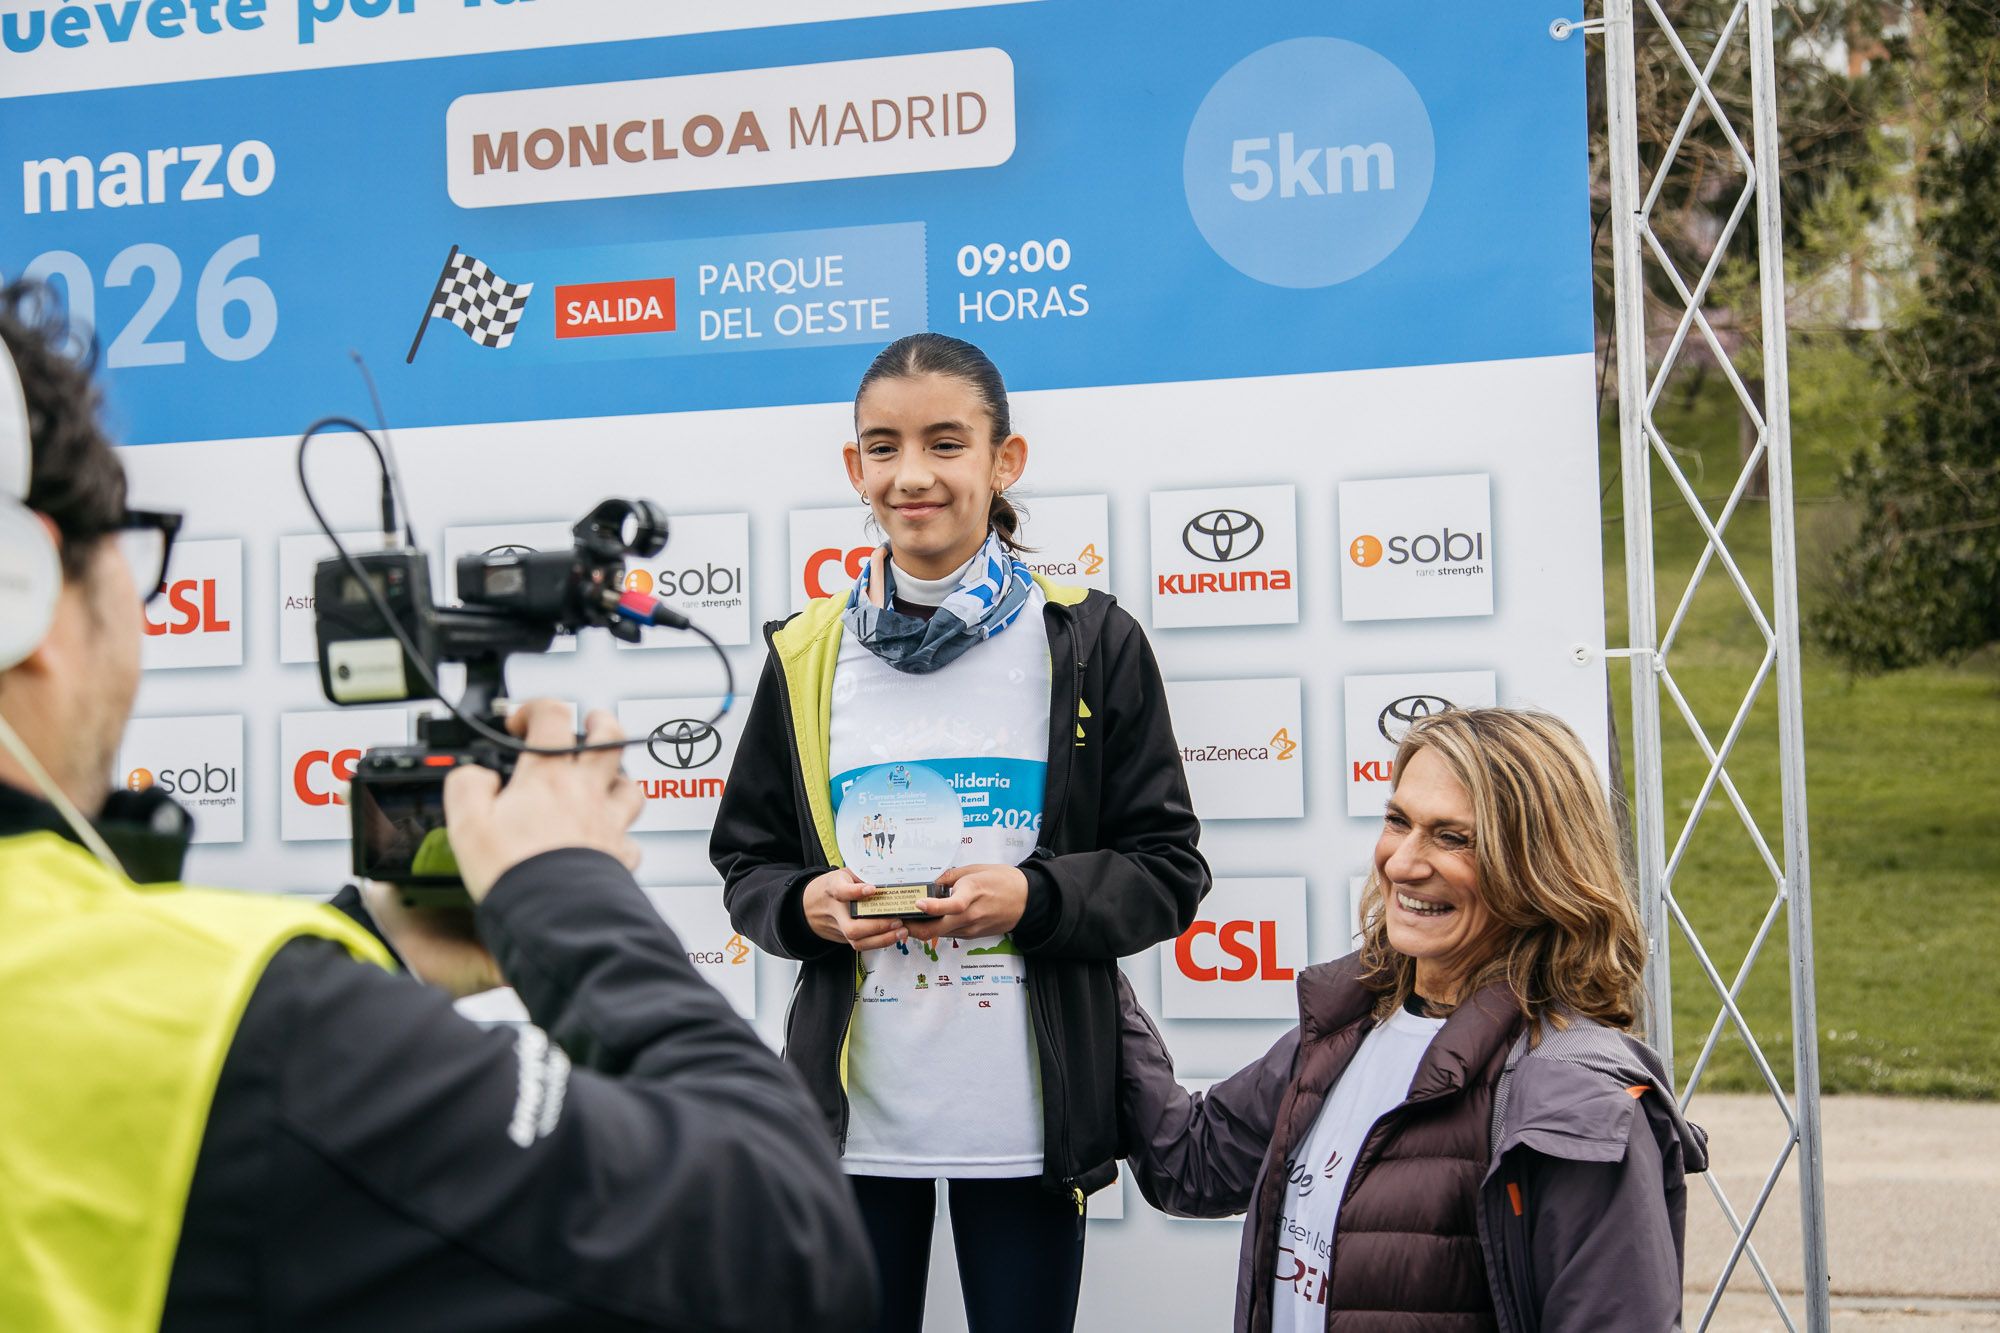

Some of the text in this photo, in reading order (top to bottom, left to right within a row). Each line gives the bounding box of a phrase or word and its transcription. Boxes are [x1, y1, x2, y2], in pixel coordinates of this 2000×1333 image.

[472, 91, 988, 176] MONCLOA MADRID
[23, 139, 276, 214] marzo
[1229, 132, 1396, 202] 5km
[700, 255, 844, 296] PARQUE
[956, 238, 1071, 278] 09:00
[0, 233, 278, 369] 026
[566, 296, 664, 326] SALIDA
[701, 298, 890, 341] DEL OESTE
[958, 283, 1089, 324] HORAS
[1388, 527, 1483, 565] sobi
[658, 562, 741, 597] sobi
[1438, 565, 1484, 577] strength
[701, 598, 742, 609] strength
[293, 748, 365, 807] CS
[638, 777, 726, 799] URUM
[199, 796, 236, 807] strength
[961, 795, 985, 803] Renal
[1175, 920, 1294, 982] CSL
